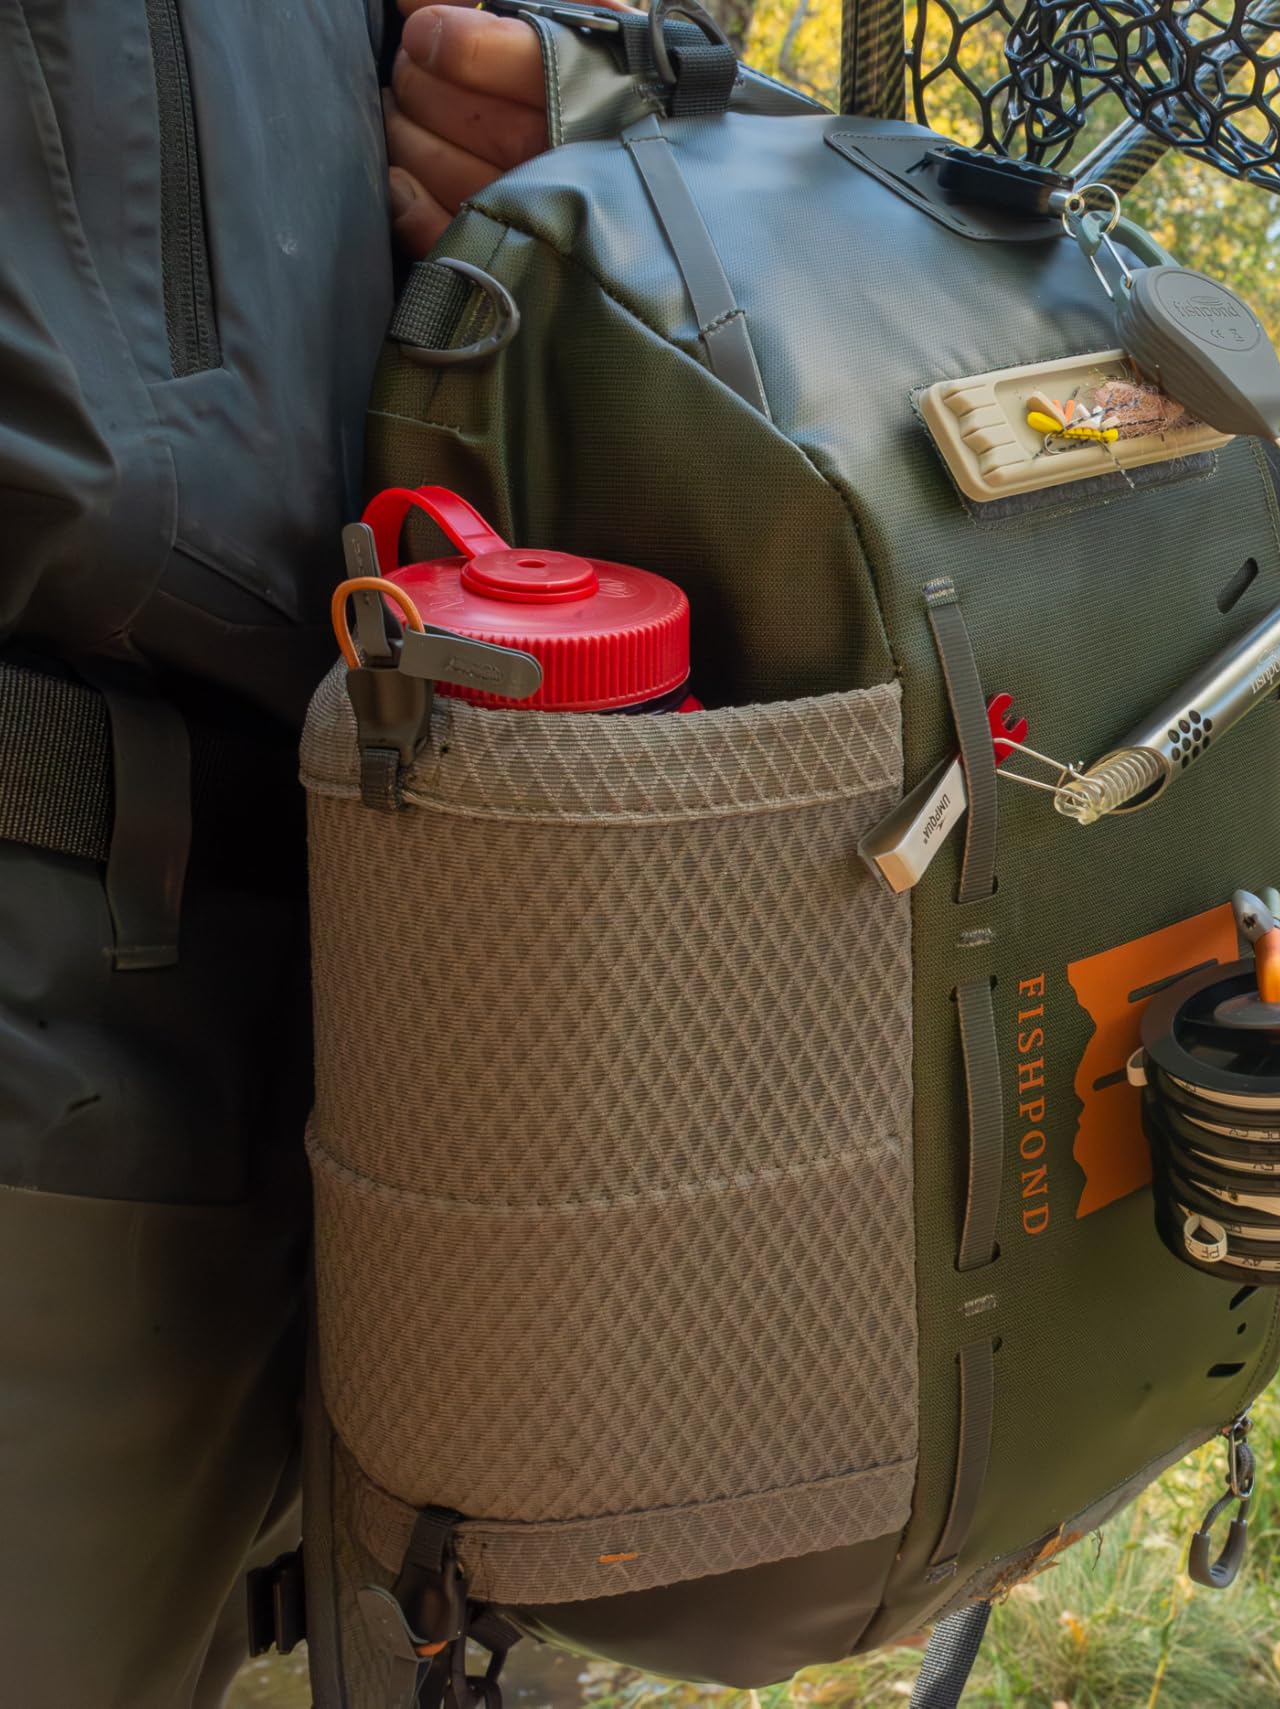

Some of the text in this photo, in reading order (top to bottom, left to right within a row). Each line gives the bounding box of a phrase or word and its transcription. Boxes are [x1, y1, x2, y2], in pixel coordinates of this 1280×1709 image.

[1172, 298, 1241, 322] fishpond
[922, 793, 951, 840] UMPQUA
[1017, 972, 1049, 1235] FISHPOND
